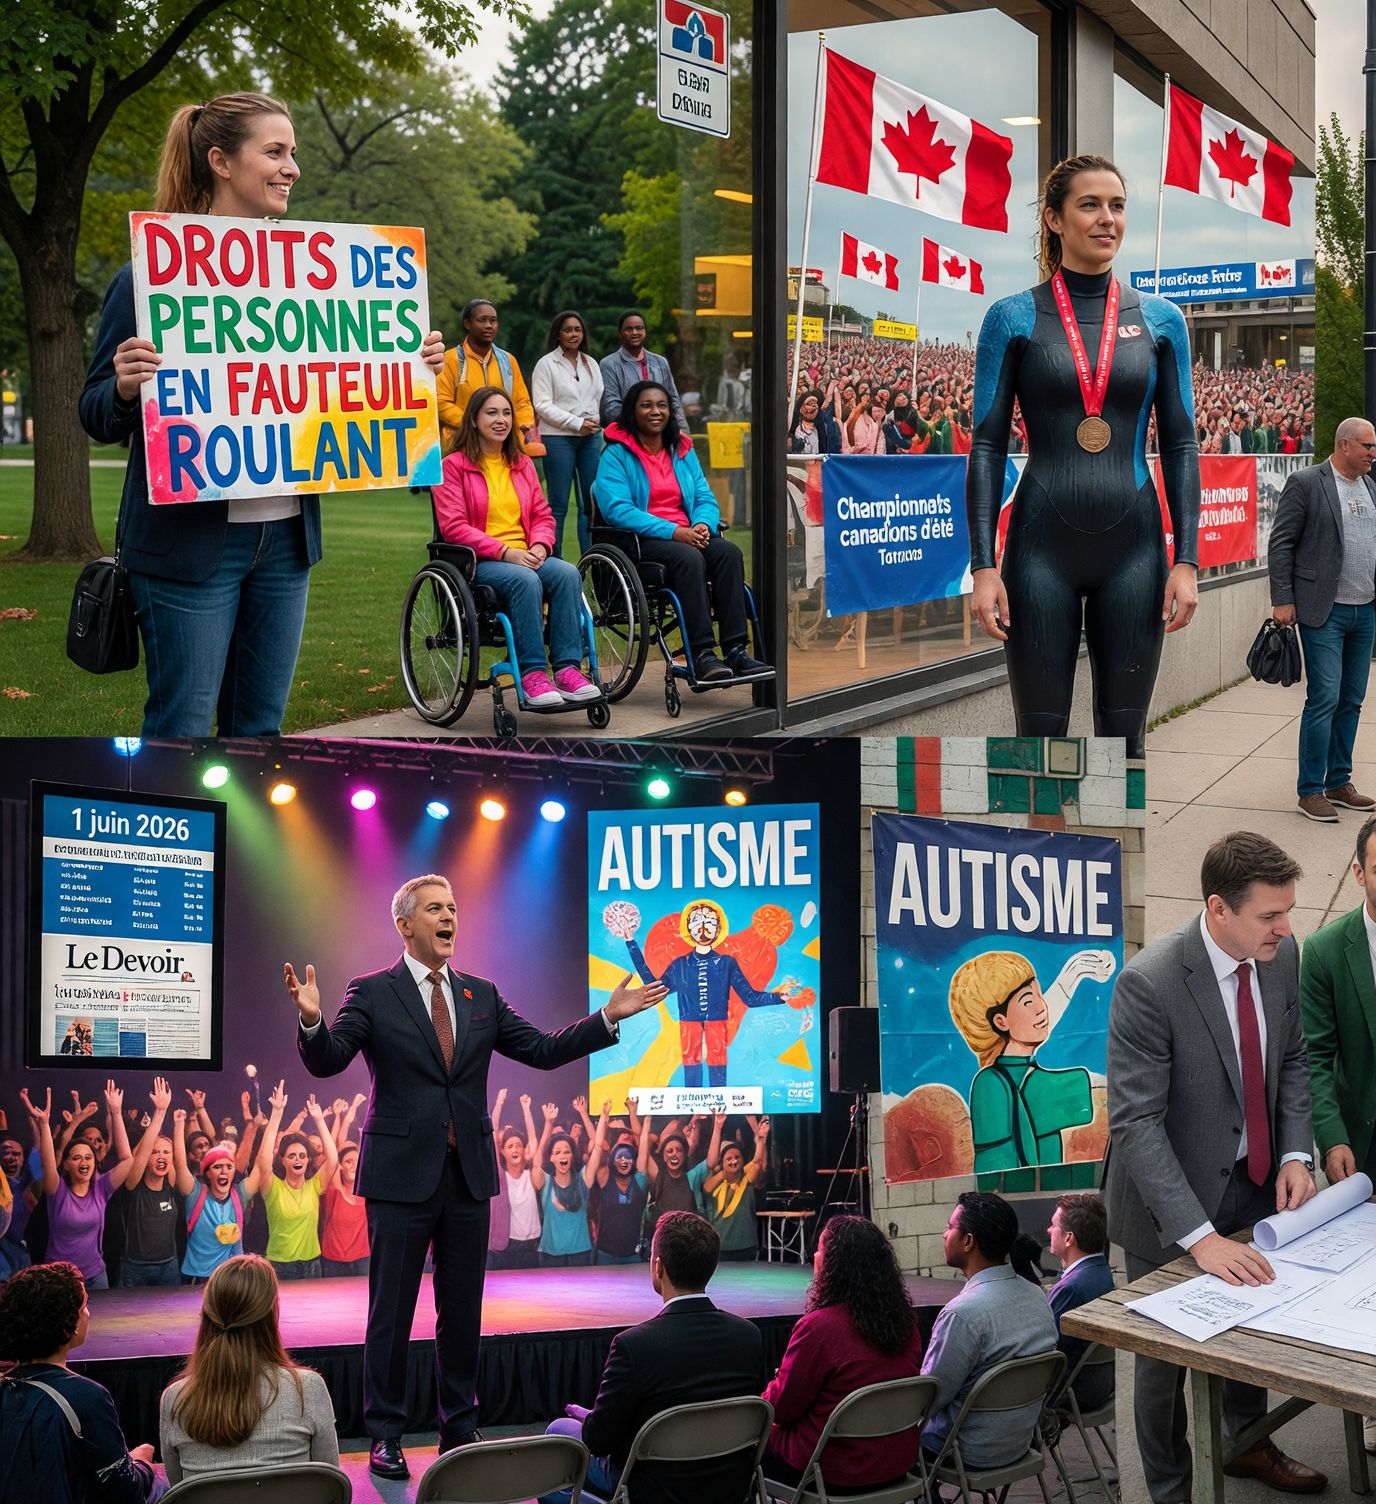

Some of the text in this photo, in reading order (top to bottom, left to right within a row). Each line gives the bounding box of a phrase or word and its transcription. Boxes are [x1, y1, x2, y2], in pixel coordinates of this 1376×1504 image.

[144, 222, 417, 290] DROITS DES
[149, 293, 422, 354] PERSONNES
[157, 362, 427, 416] EN FAUTEUIL
[167, 417, 417, 493] ROULANT
[71, 807, 190, 841] 1 juin 2026
[597, 819, 812, 891] AUTISME
[888, 841, 1113, 937] AUTISME
[65, 943, 185, 974] Le Devoir
